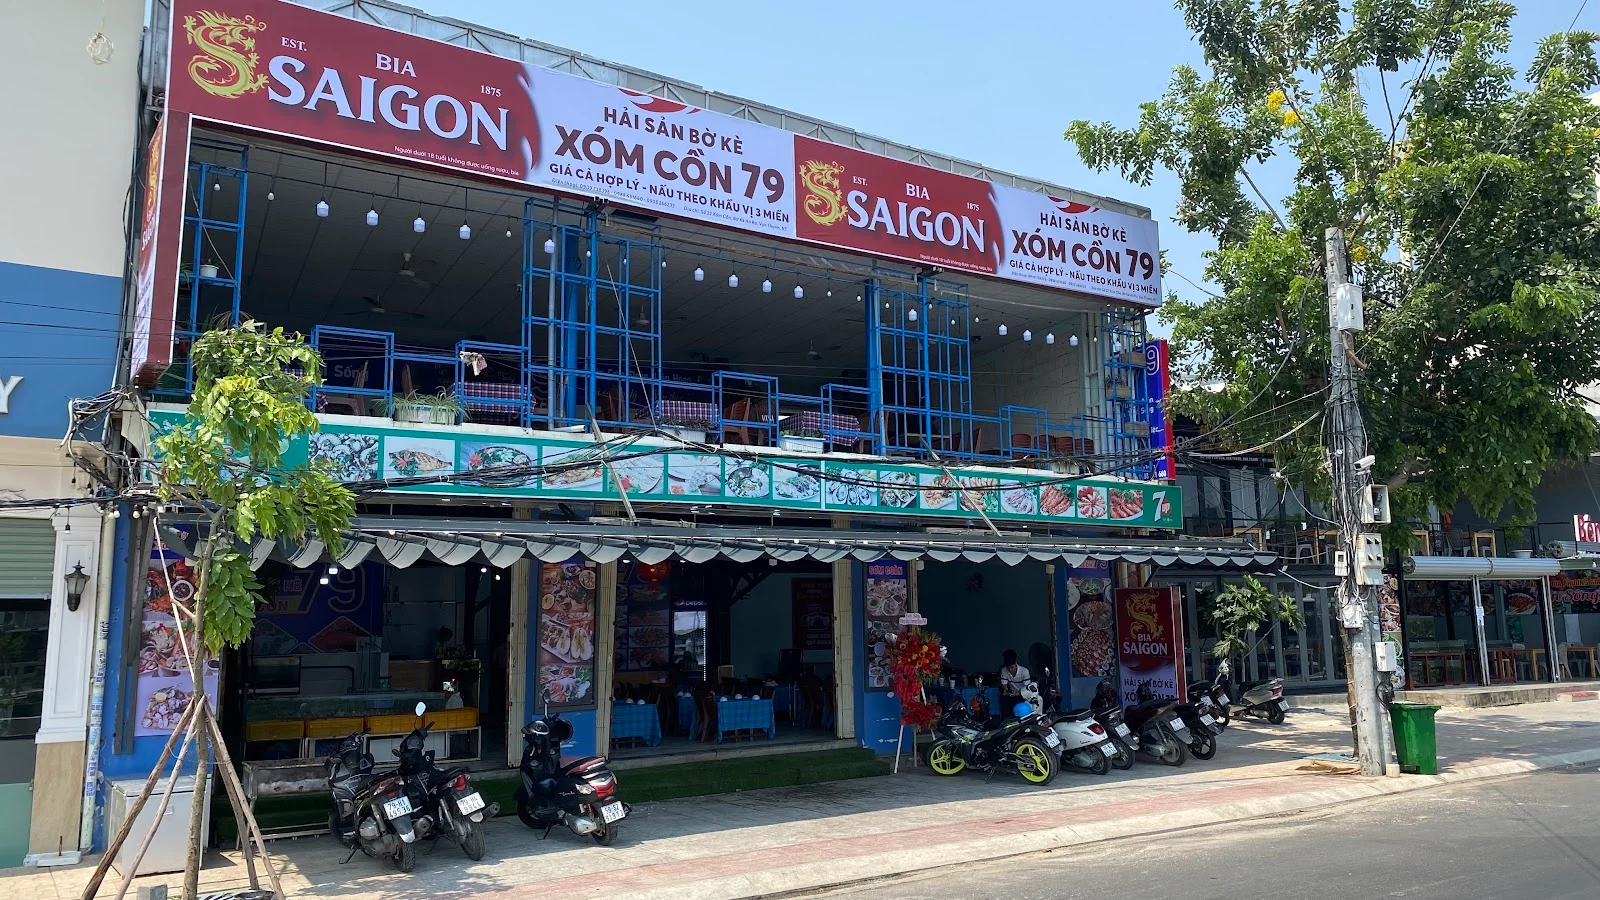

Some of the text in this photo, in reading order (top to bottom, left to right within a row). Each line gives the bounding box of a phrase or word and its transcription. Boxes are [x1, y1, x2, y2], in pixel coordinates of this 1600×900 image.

[281, 37, 307, 51] EST.
[376, 53, 417, 78] BIA
[268, 55, 509, 150] SAIGON
[480, 84, 502, 98] 1875
[604, 106, 743, 155] HẢI SẢN BỜ KÈ
[554, 124, 785, 204] XÓM CỒN 79
[549, 163, 573, 177] GIÁ
[596, 172, 624, 188] HỢP
[626, 178, 640, 191] LÝ
[649, 184, 674, 199] NẤU
[676, 190, 707, 205] THEO
[742, 204, 753, 218] VỊ
[755, 208, 761, 217] 3
[853, 175, 868, 186] EST.
[905, 183, 930, 201] BIA
[967, 202, 980, 211] 1875
[847, 190, 985, 253] SAIGON
[1040, 211, 1127, 243] HẢI SẢN BỜ KÈ
[1012, 228, 1066, 264] XÓM
[1071, 239, 1121, 275] CỒN
[1125, 248, 1154, 281] 79
[1009, 259, 1024, 271] GIÁ
[1038, 264, 1054, 277] HỢP
[1055, 266, 1064, 276] LÝ
[1086, 274, 1105, 285] THEO
[1128, 282, 1135, 293] VỊ
[1136, 284, 1140, 292] 3
[1123, 641, 1168, 656] SAIGON
[1137, 633, 1152, 642] BIA
